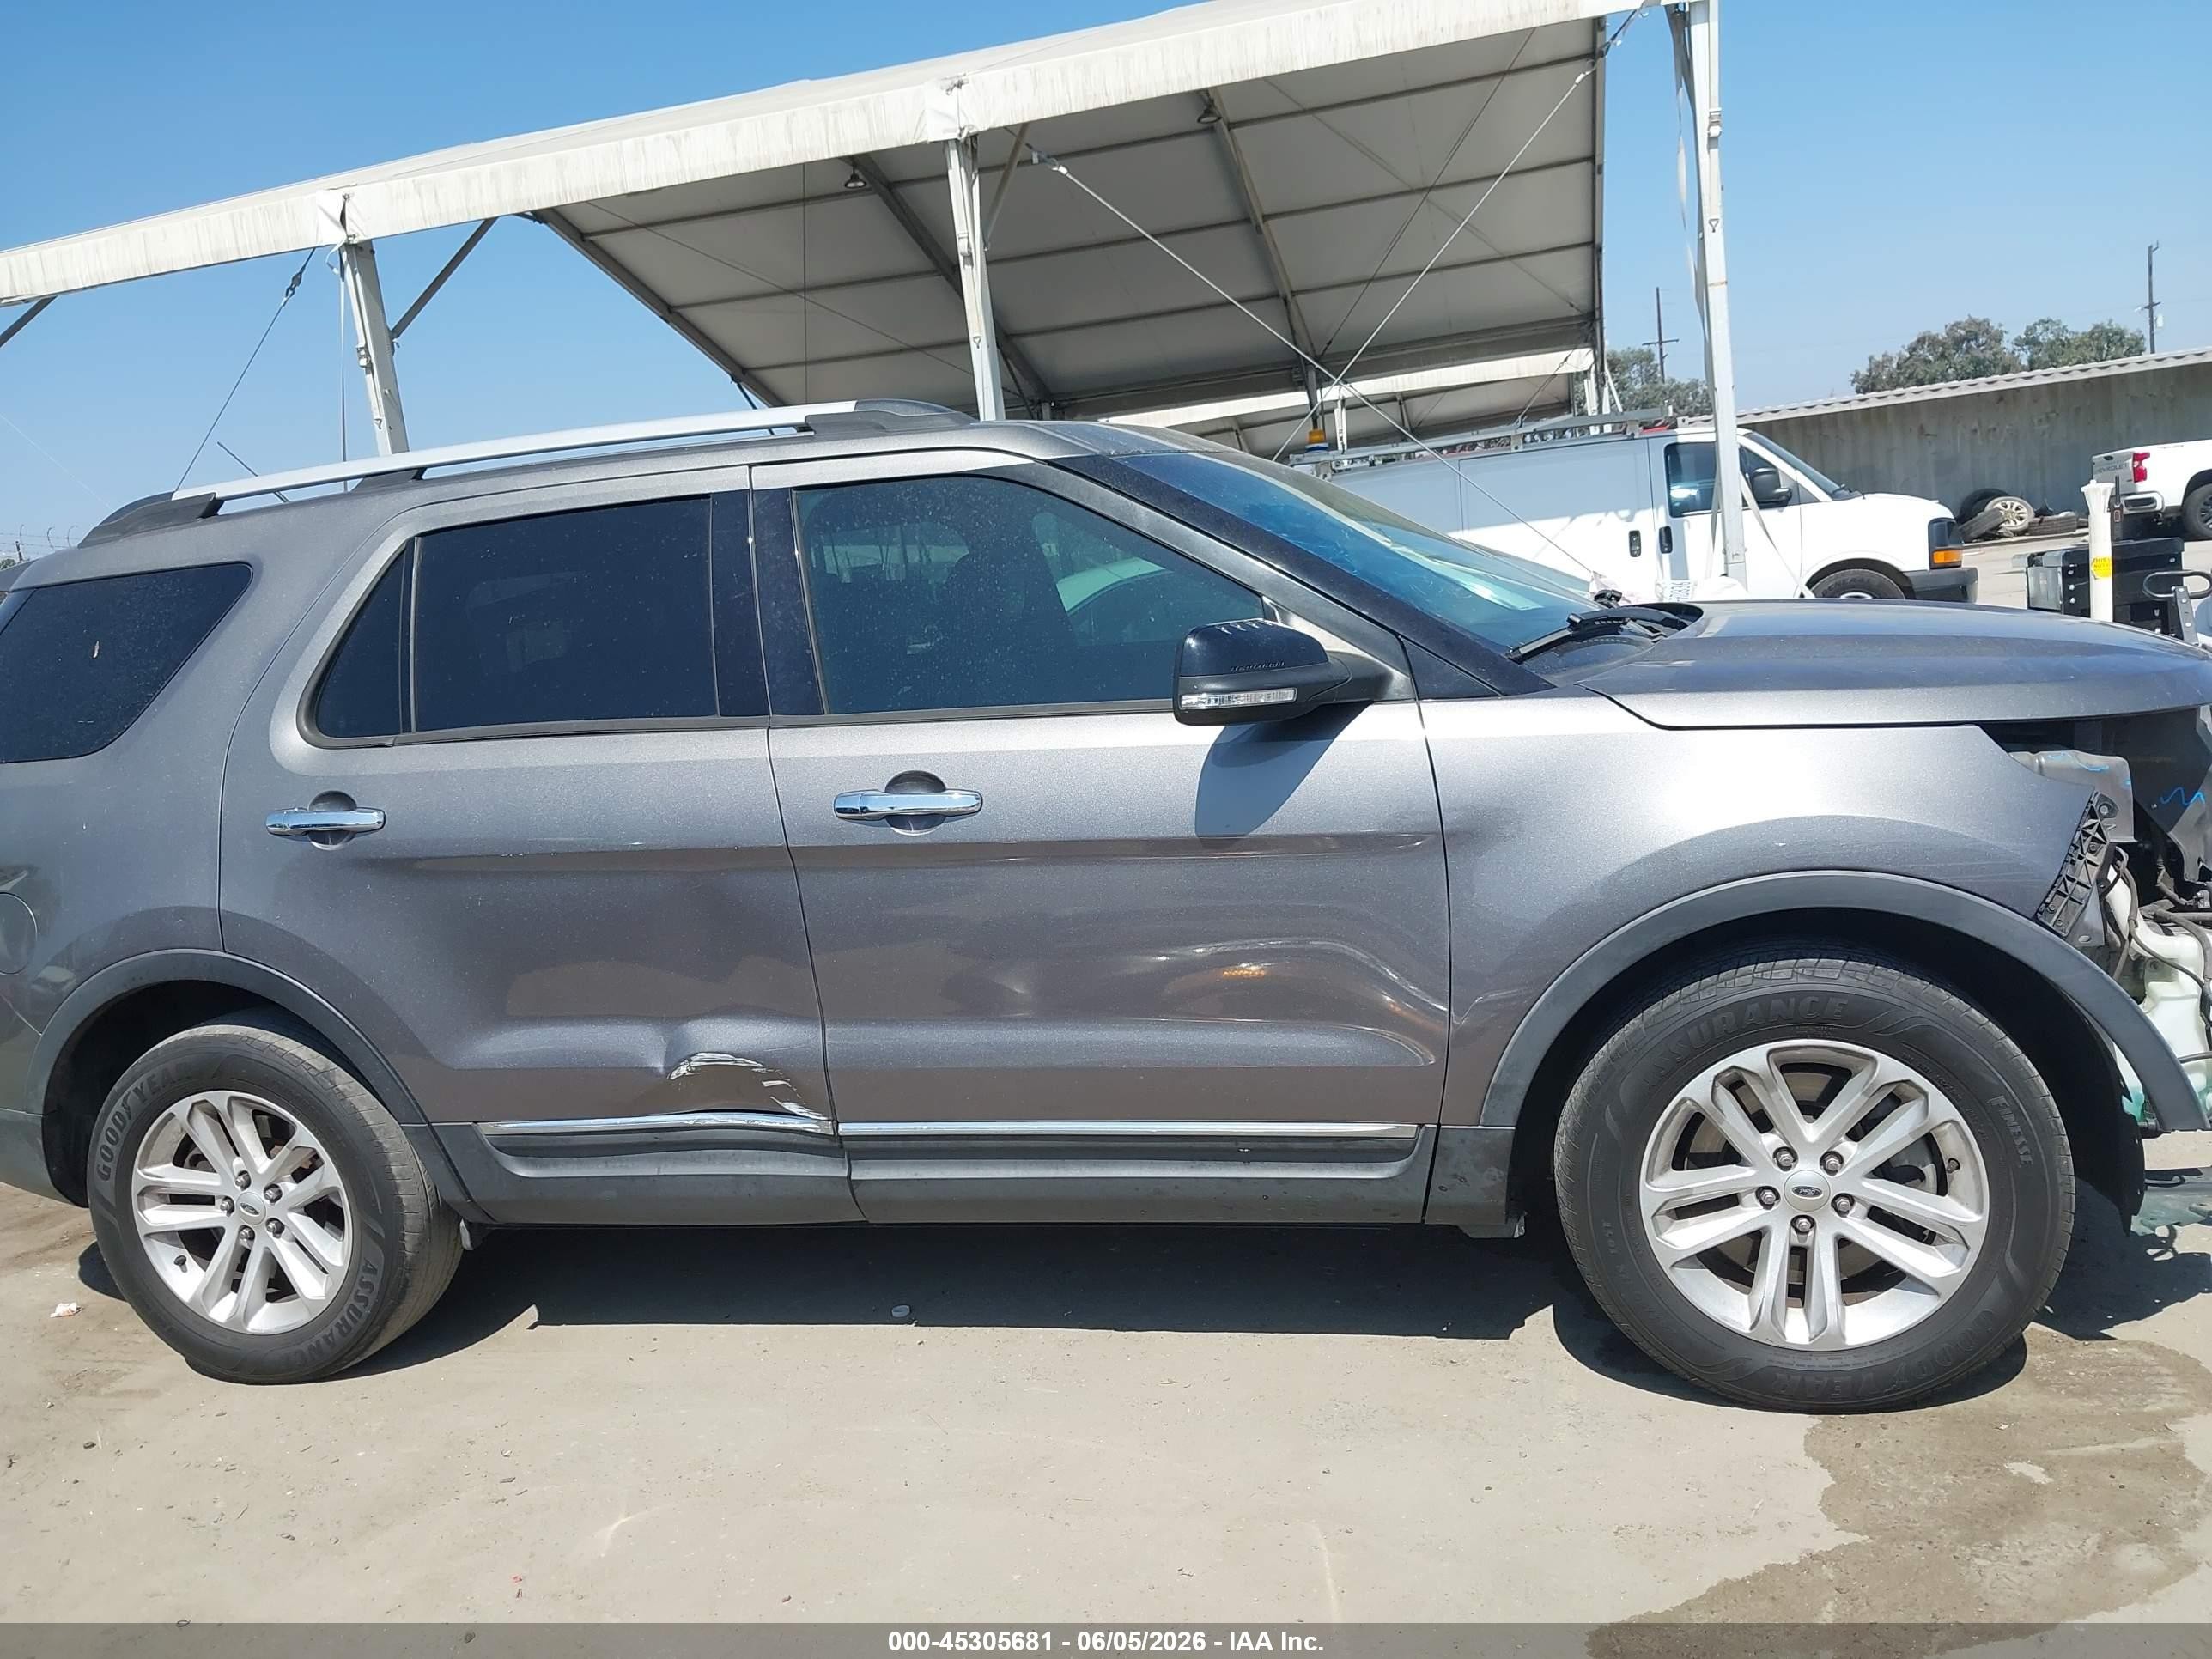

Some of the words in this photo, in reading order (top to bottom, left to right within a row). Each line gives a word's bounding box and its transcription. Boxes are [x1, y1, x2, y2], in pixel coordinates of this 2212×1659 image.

[1643, 996, 1848, 1086] ASSURANCE
[96, 1061, 189, 1182] GOODYEAR
[1986, 1095, 2033, 1168] FINESSE
